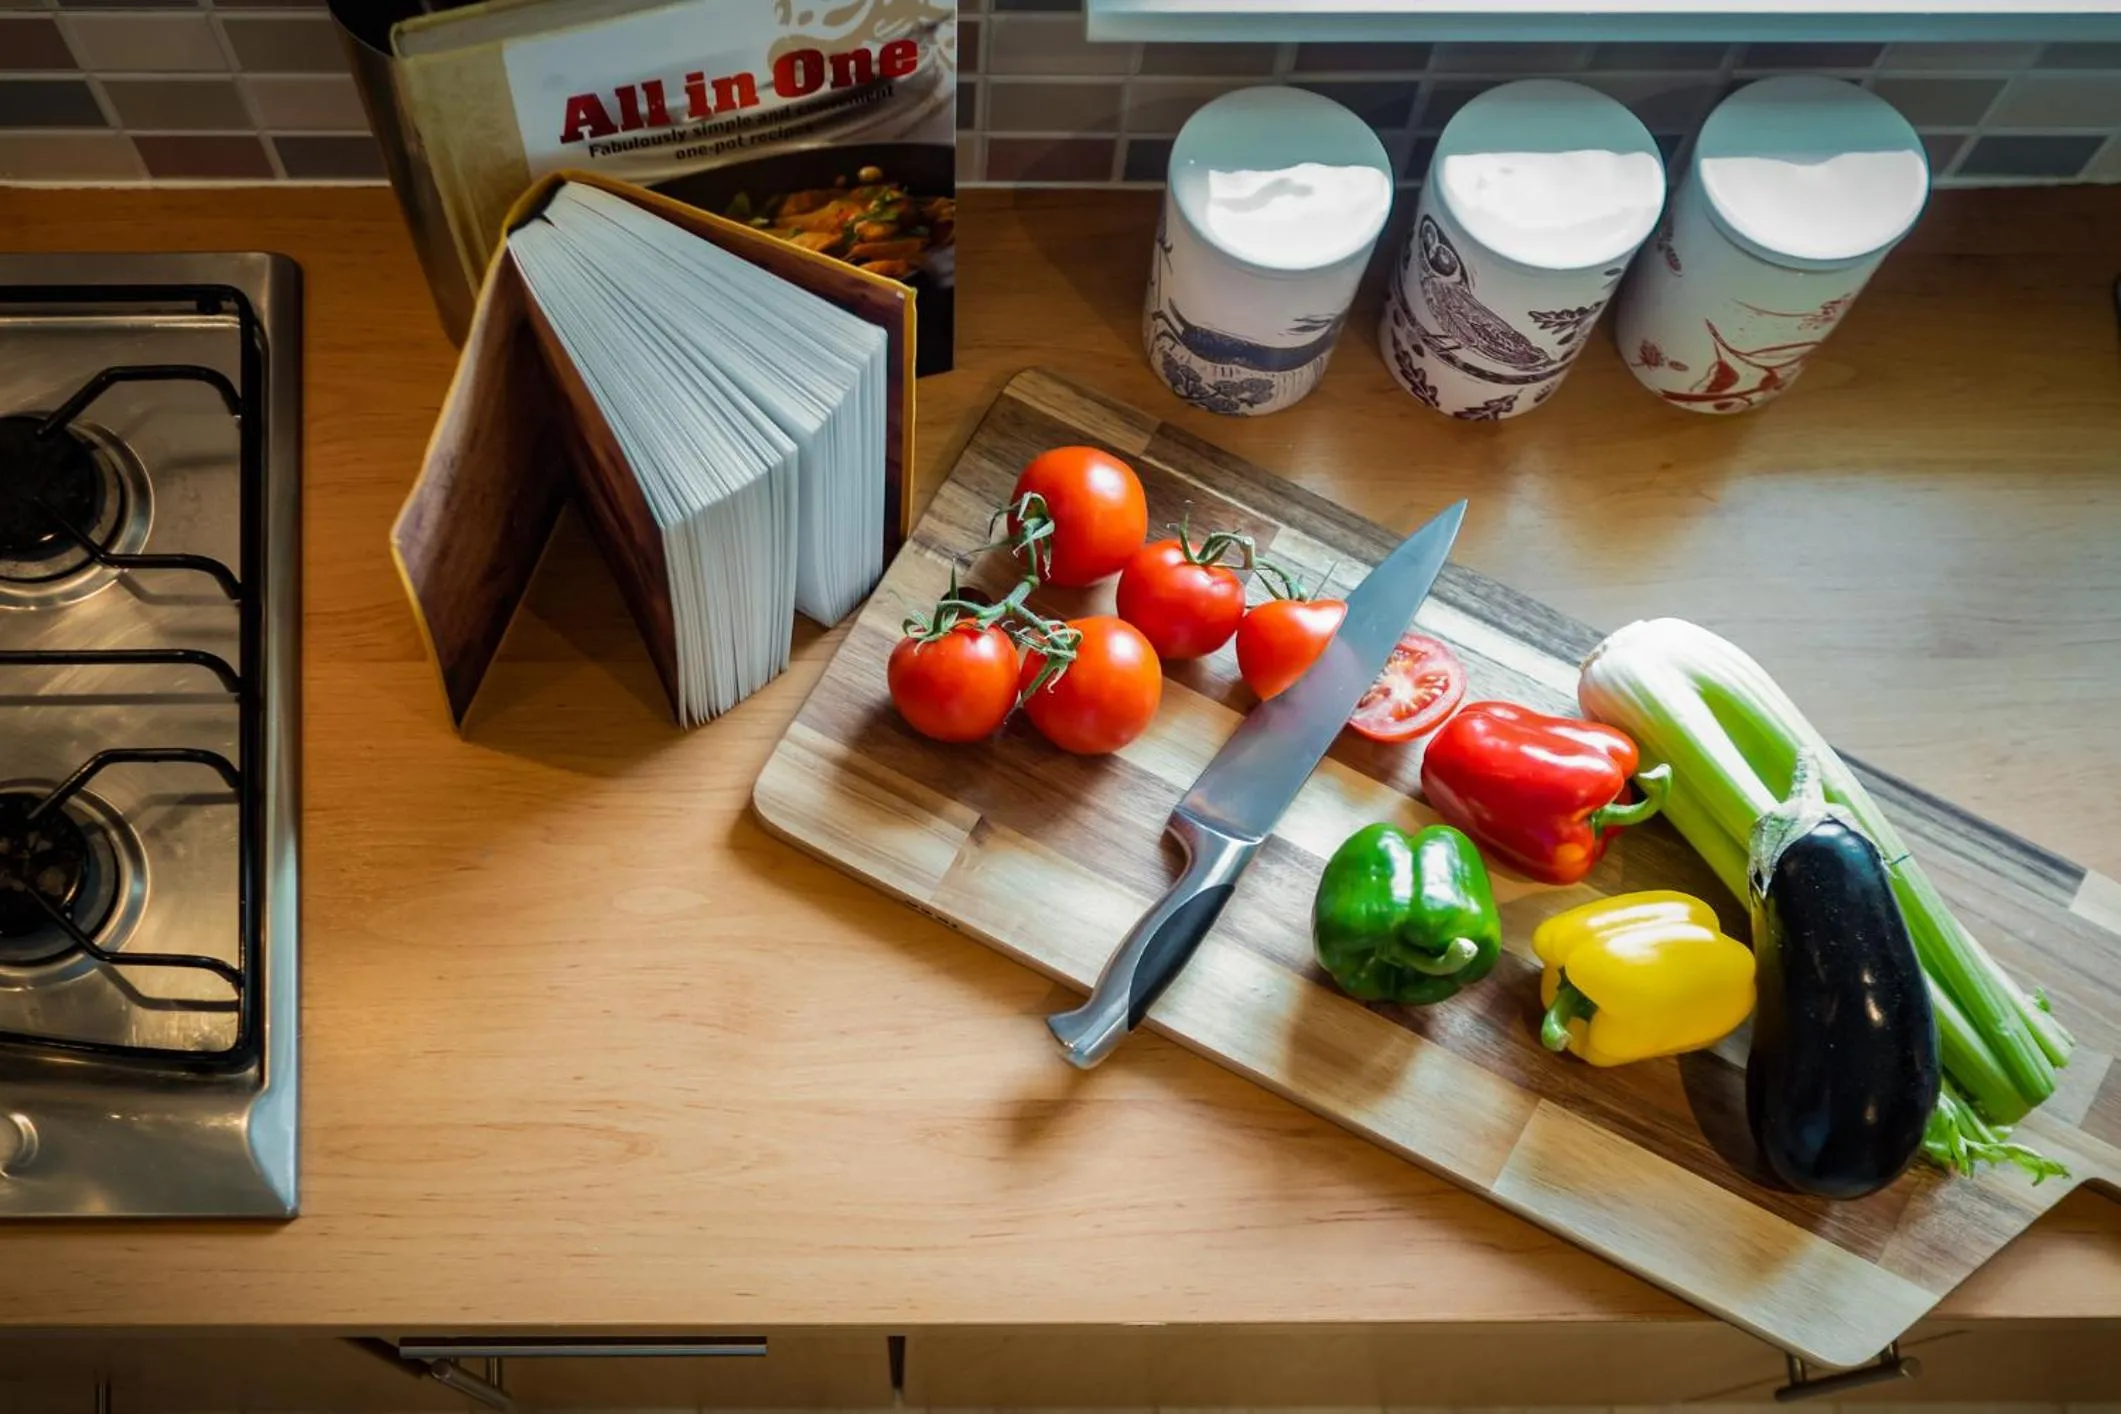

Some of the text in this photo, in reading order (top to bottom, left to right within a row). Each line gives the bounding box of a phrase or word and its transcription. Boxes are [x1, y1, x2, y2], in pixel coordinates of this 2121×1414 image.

[559, 39, 918, 144] All in One
[588, 129, 687, 158] Fabulously
[692, 115, 751, 137] simple
[757, 104, 791, 128] and
[675, 135, 745, 160] one-pot
